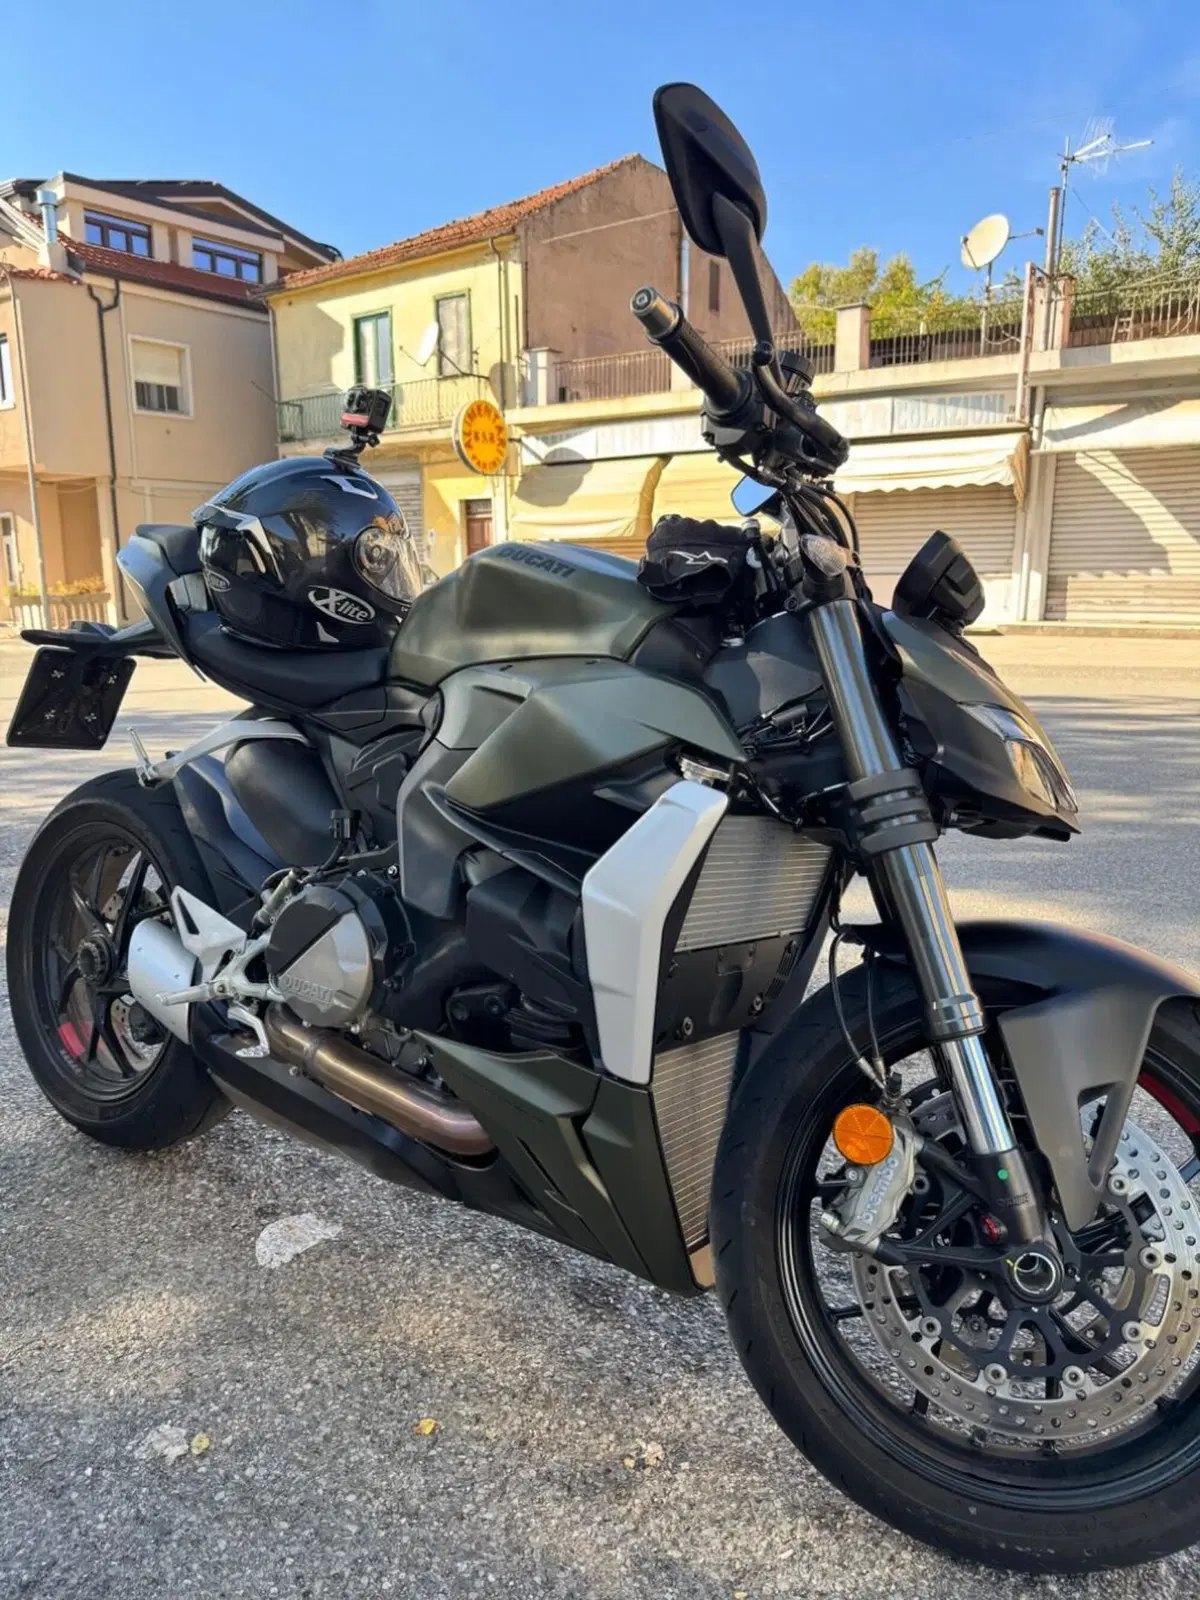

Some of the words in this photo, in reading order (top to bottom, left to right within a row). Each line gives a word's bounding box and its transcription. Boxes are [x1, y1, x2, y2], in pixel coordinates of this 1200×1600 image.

[463, 403, 507, 457] ALIMENTARI
[497, 547, 576, 578] DUCATI
[316, 589, 369, 622] X-lite
[278, 976, 335, 1003] DUCATI
[857, 1157, 899, 1225] brembo
